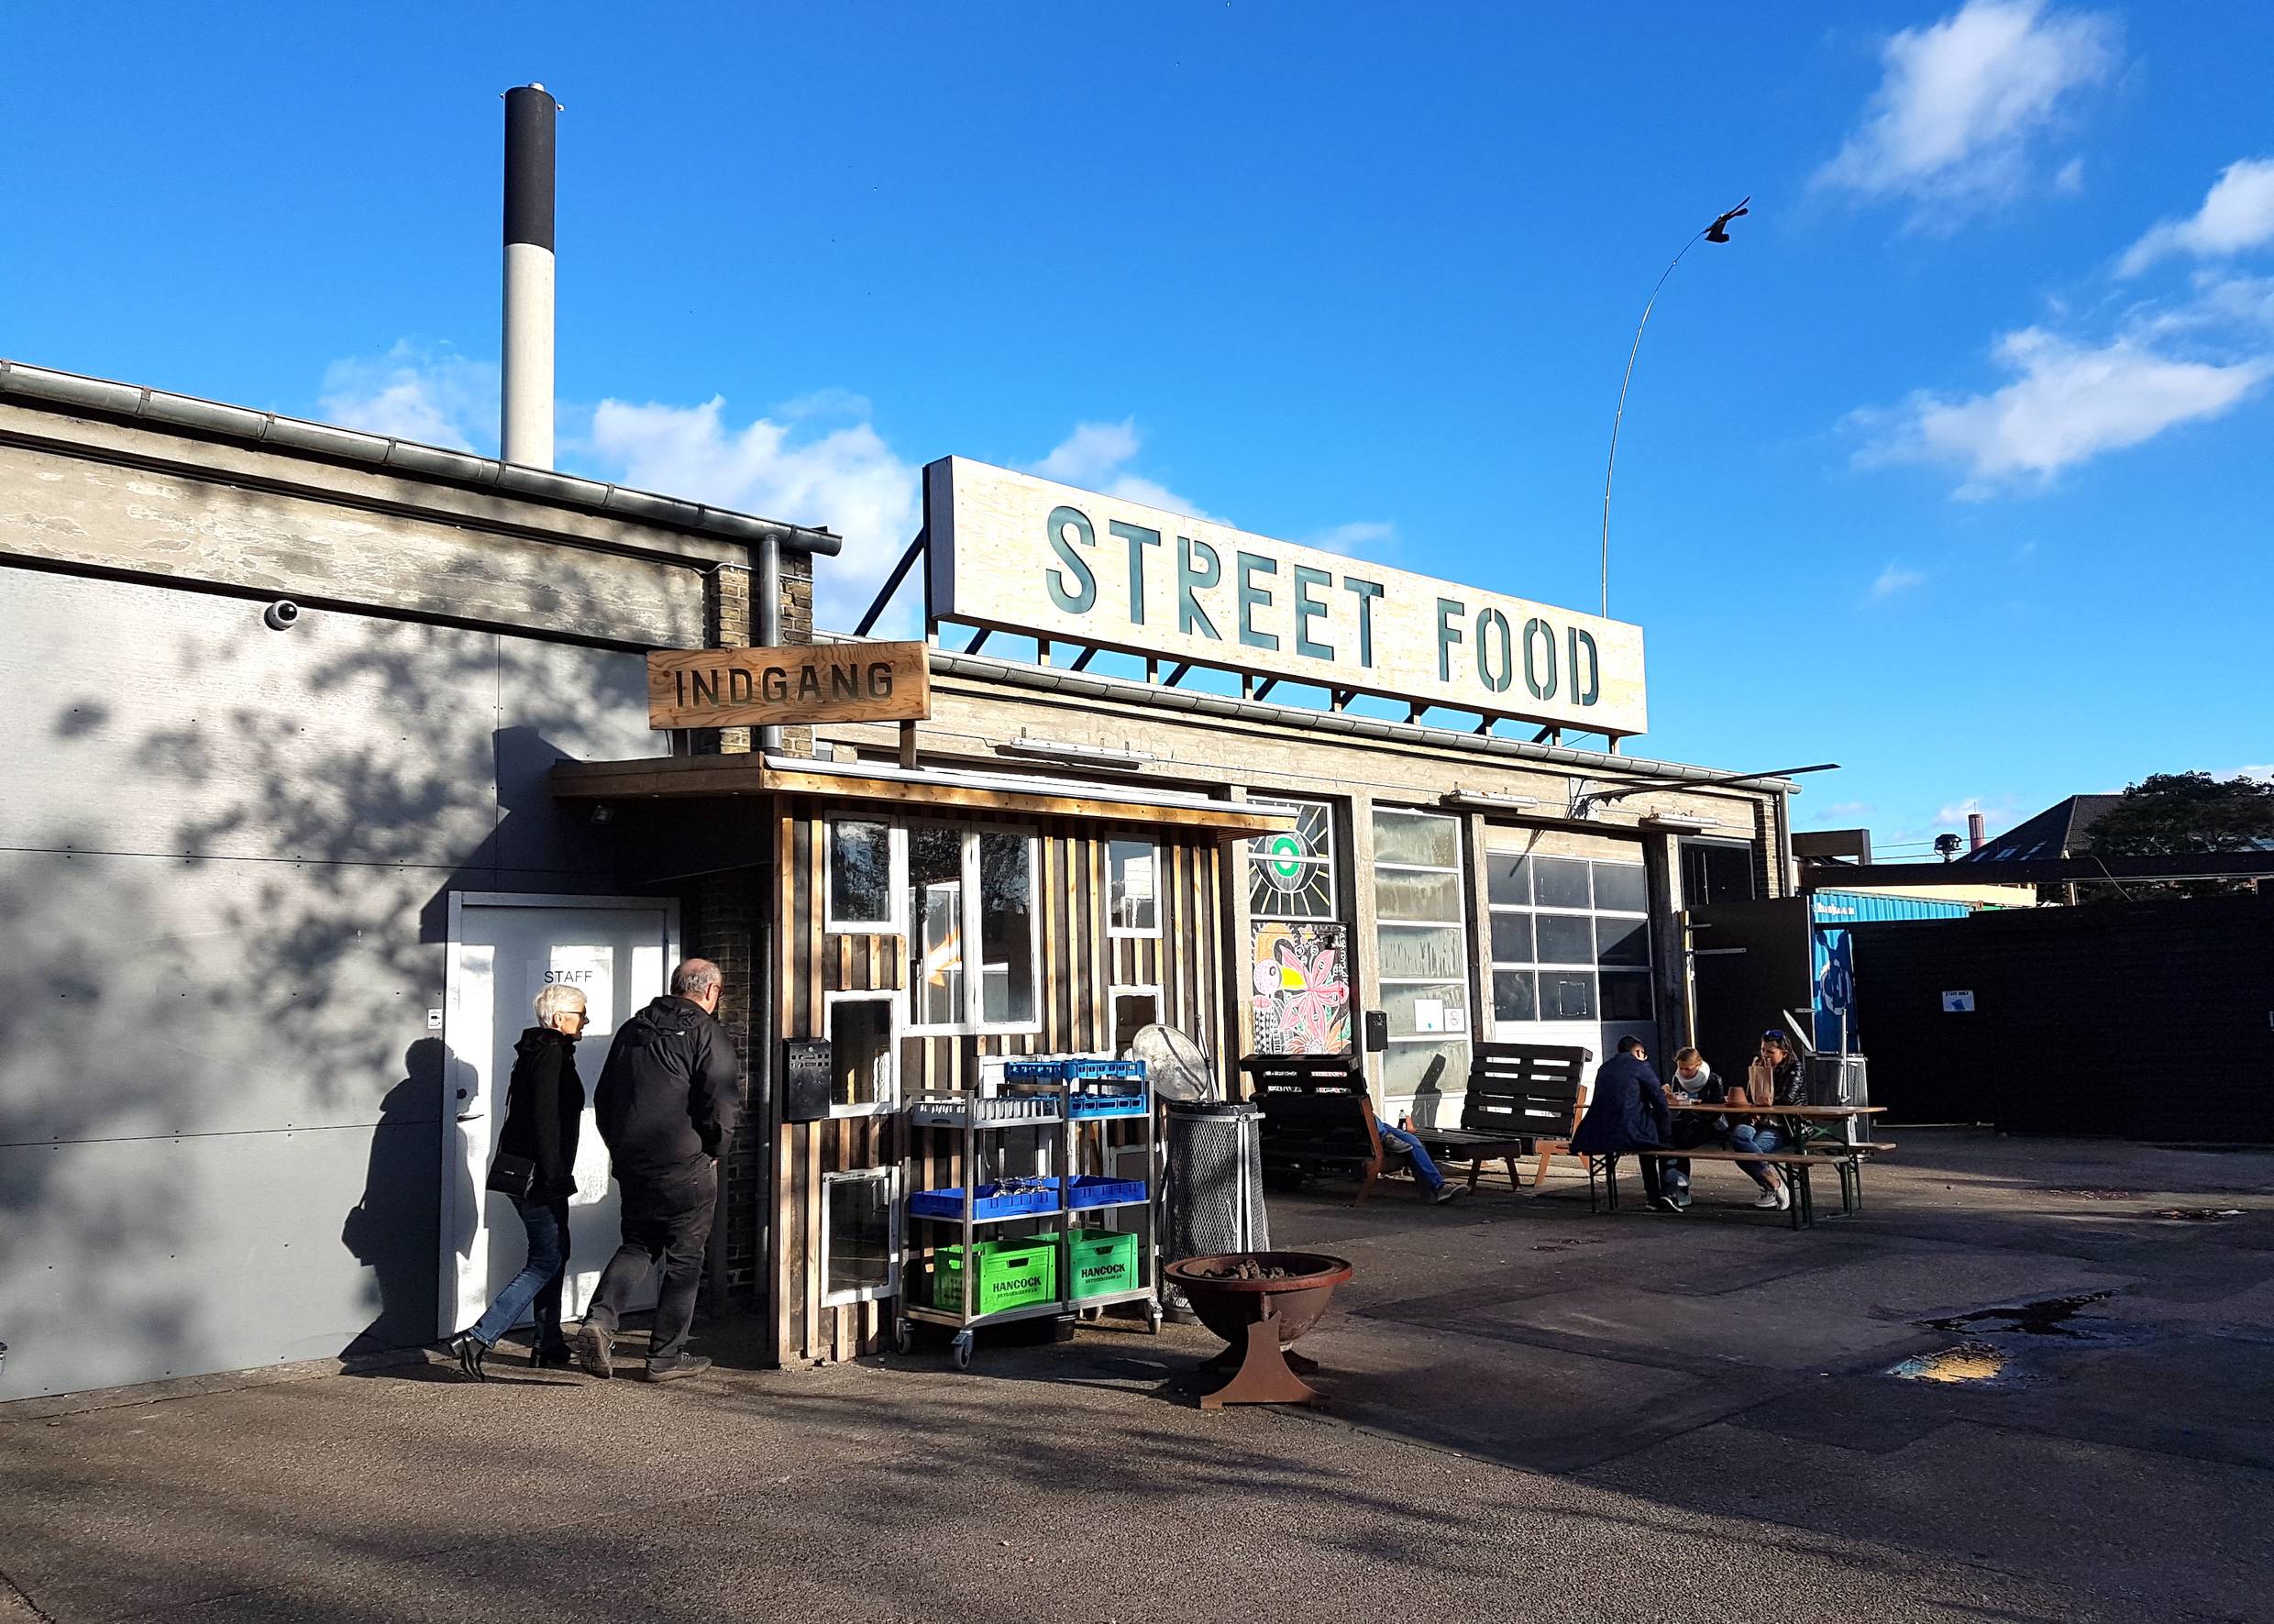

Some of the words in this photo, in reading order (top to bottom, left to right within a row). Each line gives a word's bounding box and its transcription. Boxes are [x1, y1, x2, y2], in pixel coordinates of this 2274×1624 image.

[1046, 505, 1385, 668] STREET
[1437, 597, 1599, 707] FOOD
[675, 662, 894, 708] INDGANG
[544, 970, 593, 983] STAFF
[1081, 1263, 1125, 1278] HANCOCK
[993, 1276, 1042, 1292] HANCOCK
